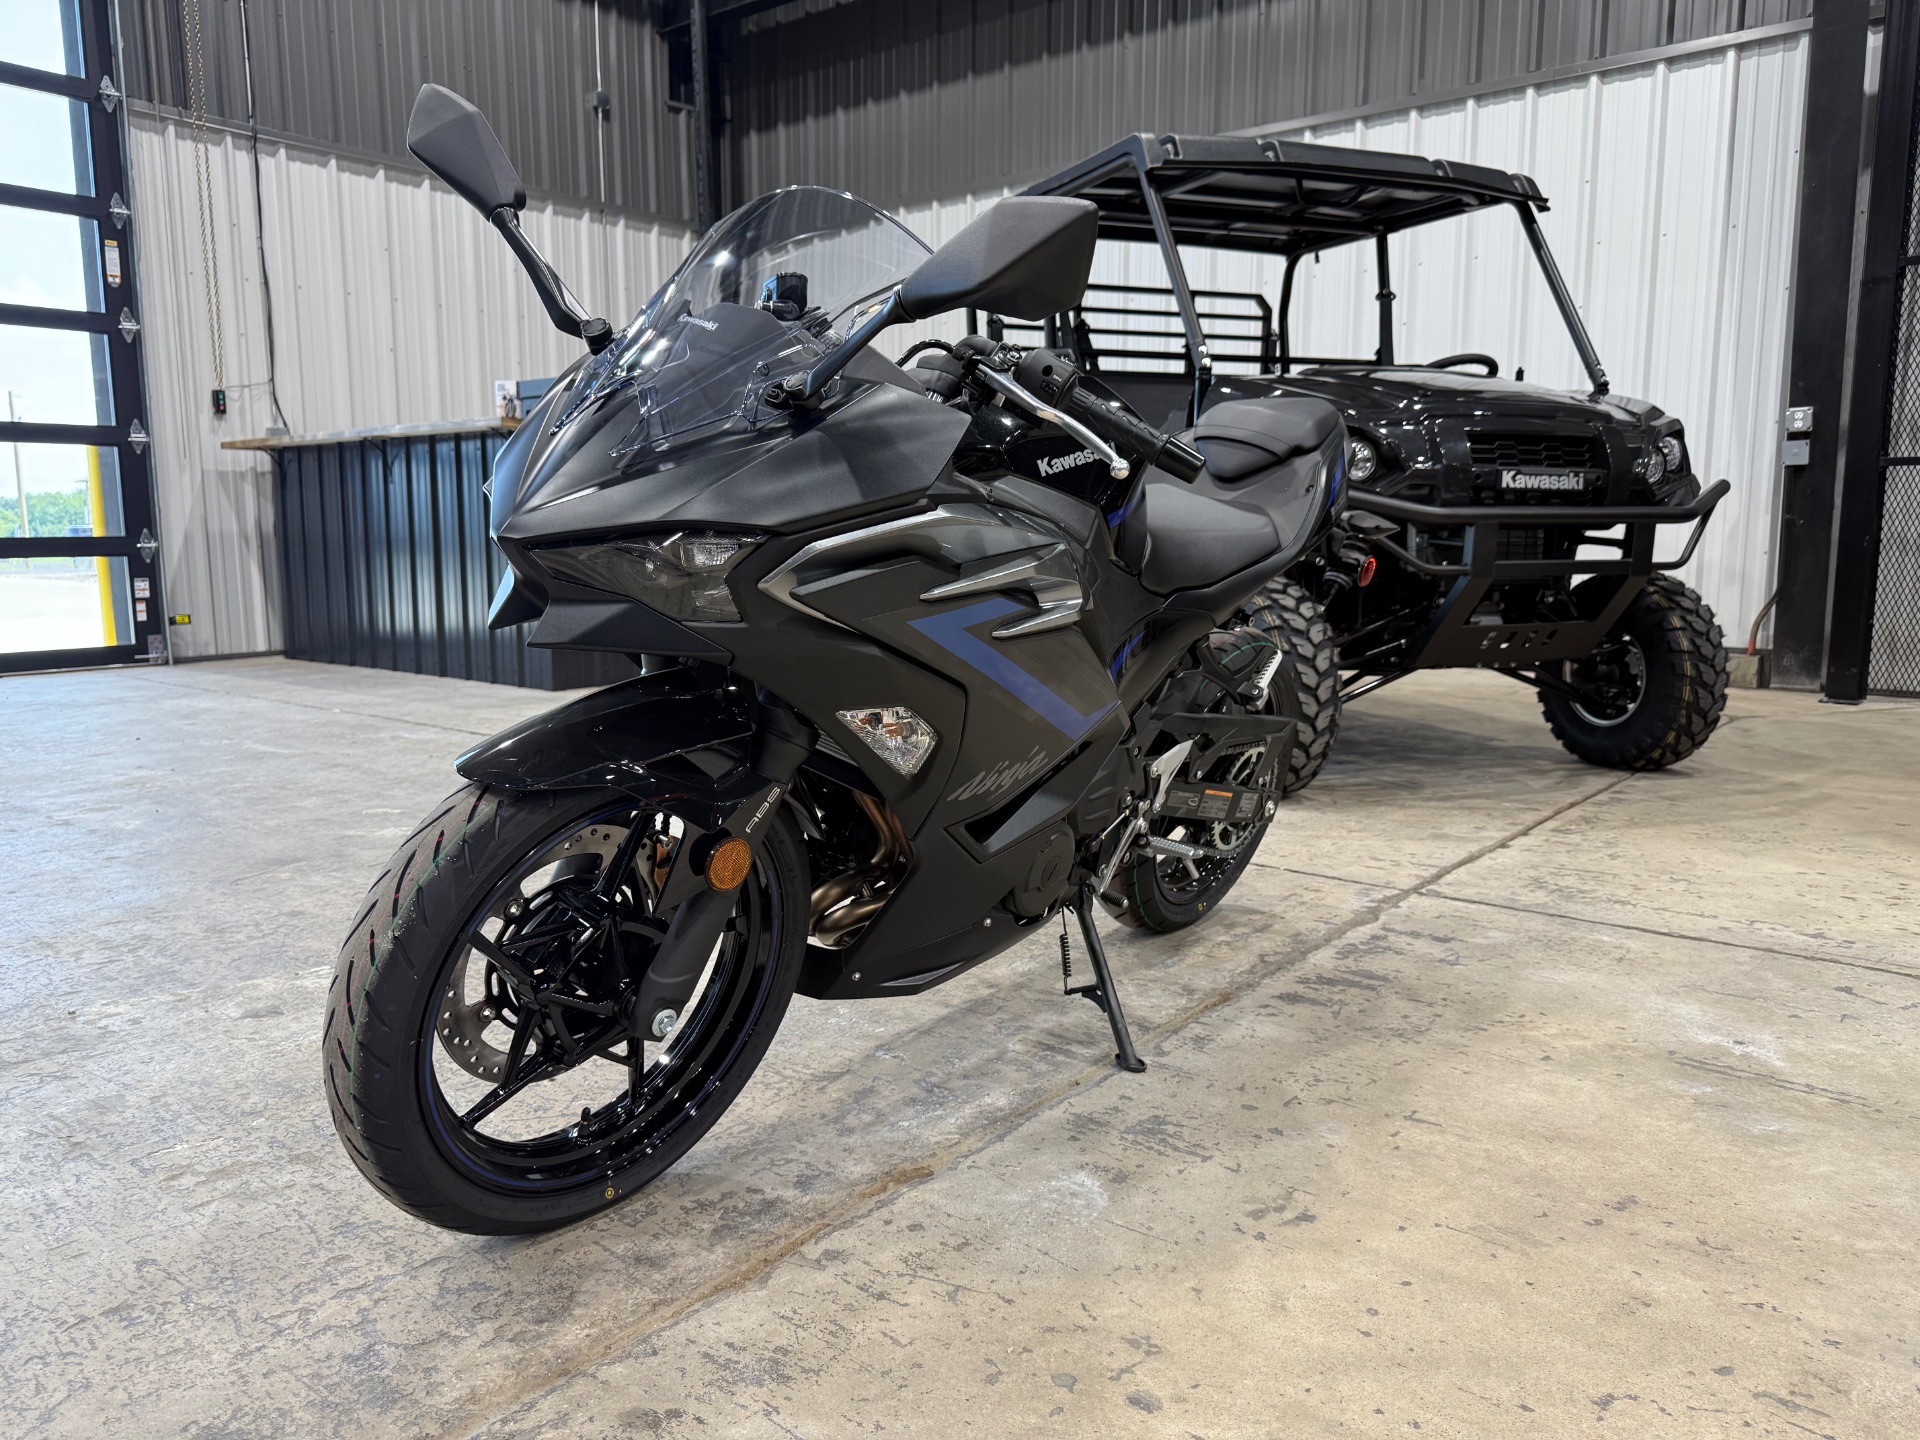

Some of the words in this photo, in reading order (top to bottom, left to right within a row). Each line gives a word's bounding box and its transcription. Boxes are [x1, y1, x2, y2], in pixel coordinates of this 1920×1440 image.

[677, 313, 719, 331] Kawasaki
[1501, 470, 1584, 490] Kawasaki
[946, 745, 1048, 801] Ninja
[745, 787, 780, 834] ABS
